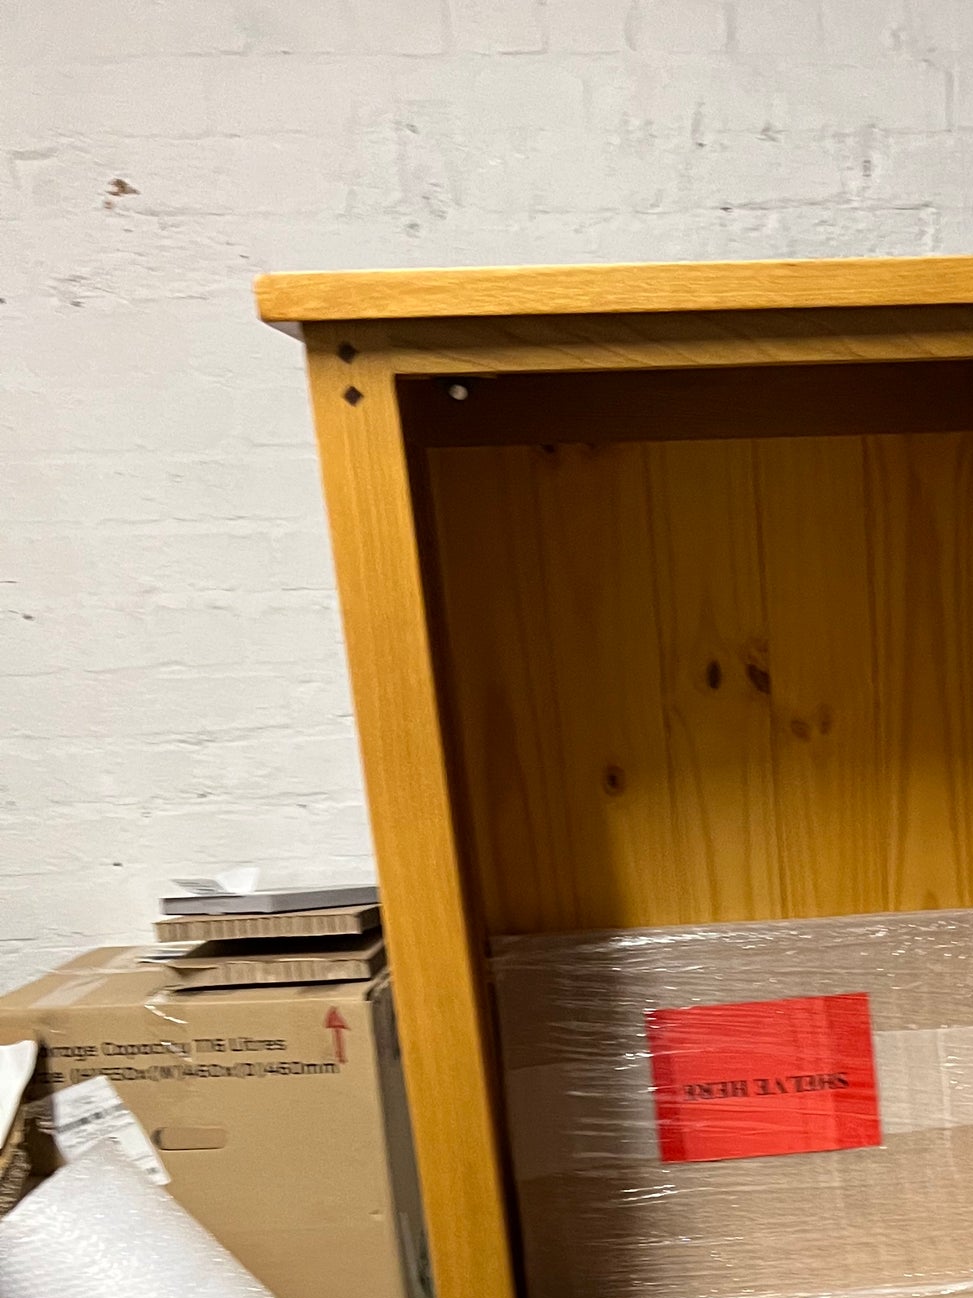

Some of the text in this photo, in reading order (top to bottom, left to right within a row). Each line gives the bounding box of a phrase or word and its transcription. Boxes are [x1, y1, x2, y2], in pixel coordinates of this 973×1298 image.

[40, 1045, 97, 1061] orage
[101, 1039, 189, 1059] Capacity
[230, 1037, 287, 1052] Litres
[684, 1072, 849, 1101] SHELVE HERE
